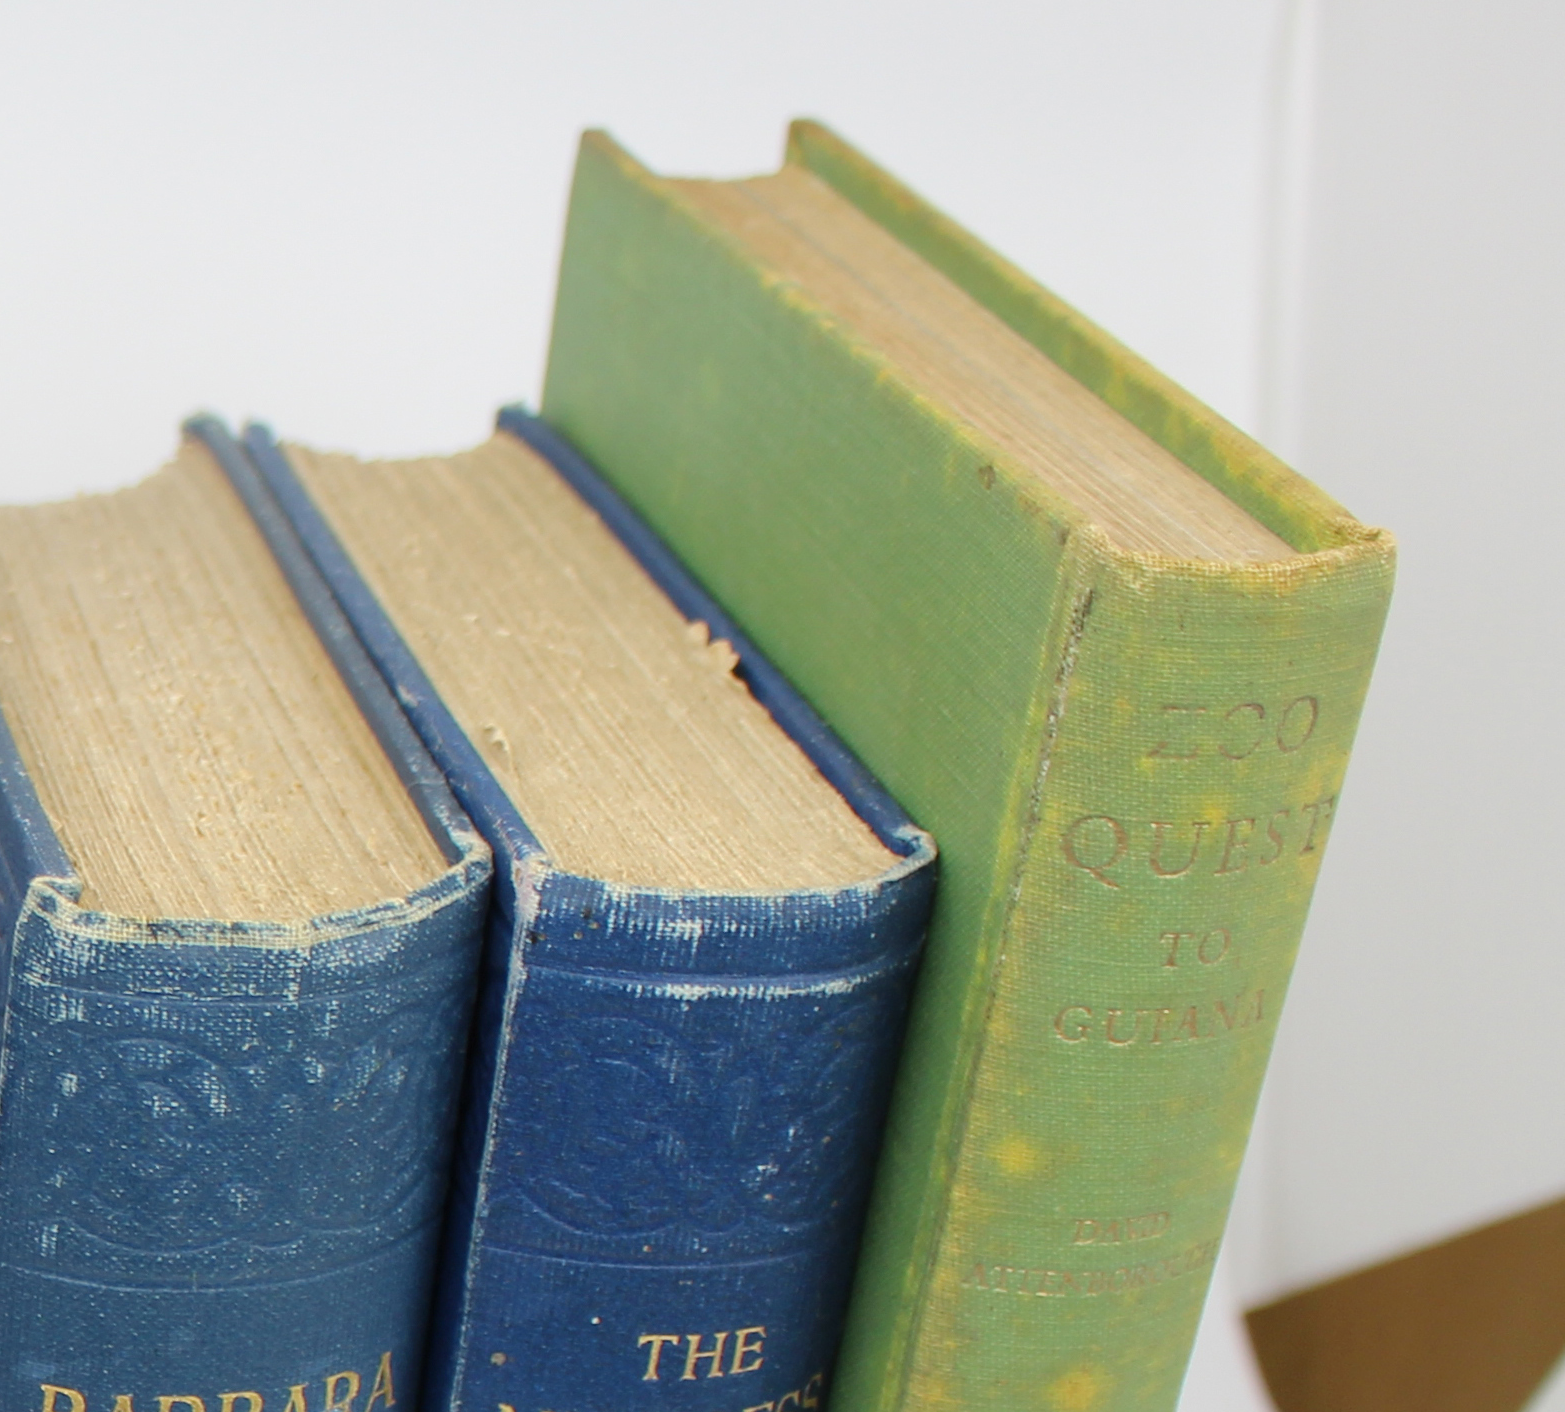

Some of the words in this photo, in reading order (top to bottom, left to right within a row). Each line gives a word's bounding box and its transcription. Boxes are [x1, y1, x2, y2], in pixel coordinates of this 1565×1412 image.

[1062, 797, 1336, 889] QUEST
[1159, 928, 1231, 968] TO
[636, 1326, 767, 1381] THE
